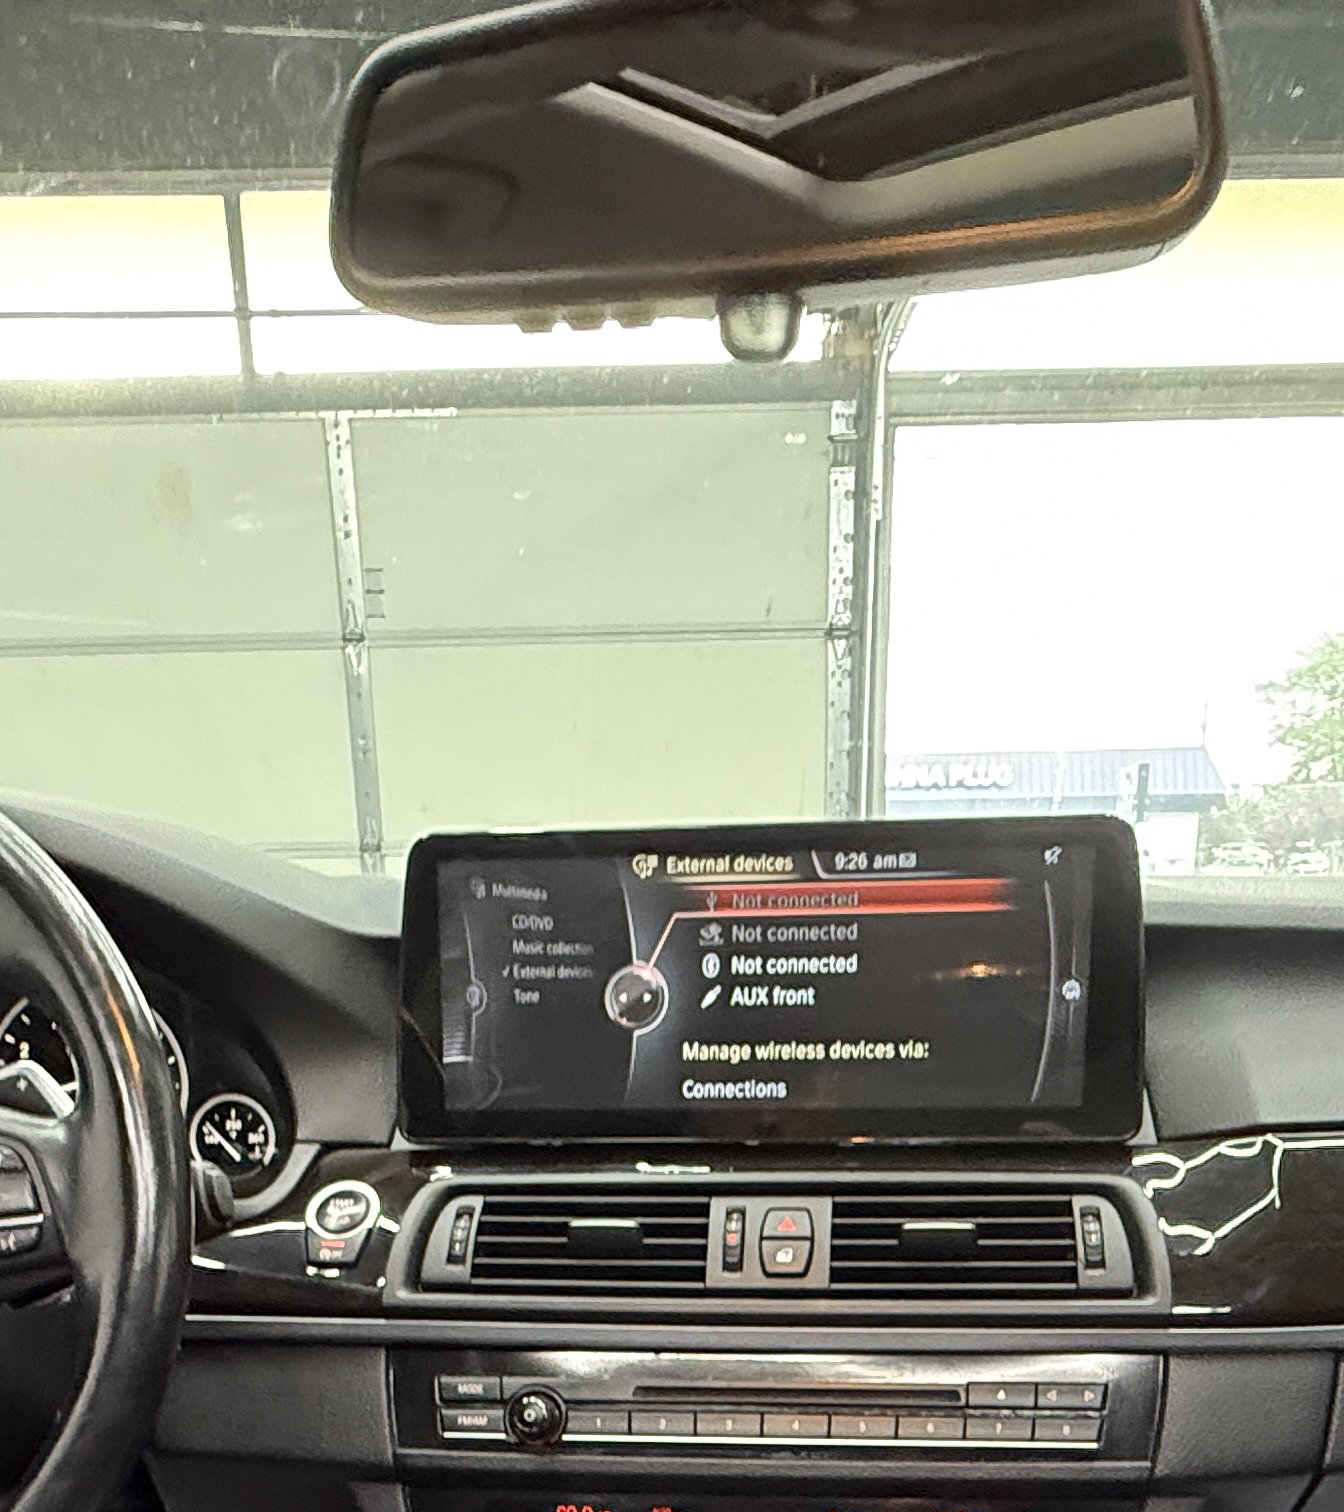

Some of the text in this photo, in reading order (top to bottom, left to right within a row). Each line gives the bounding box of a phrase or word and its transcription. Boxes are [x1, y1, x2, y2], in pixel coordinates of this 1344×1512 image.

[666, 855, 794, 875] External devices
[834, 851, 899, 871] 9:26 am
[732, 891, 859, 910] Not connected
[512, 913, 554, 931] CD/DVD
[731, 922, 859, 943] Not connected
[512, 938, 544, 954] Music
[512, 963, 556, 979] External
[730, 953, 858, 975] Not connected
[513, 988, 541, 1004] Tone
[729, 985, 816, 1006] AUX front
[19, 1042, 30, 1059] 2
[682, 1039, 930, 1064] Manage wireless devices via:
[681, 1079, 788, 1100] Connections
